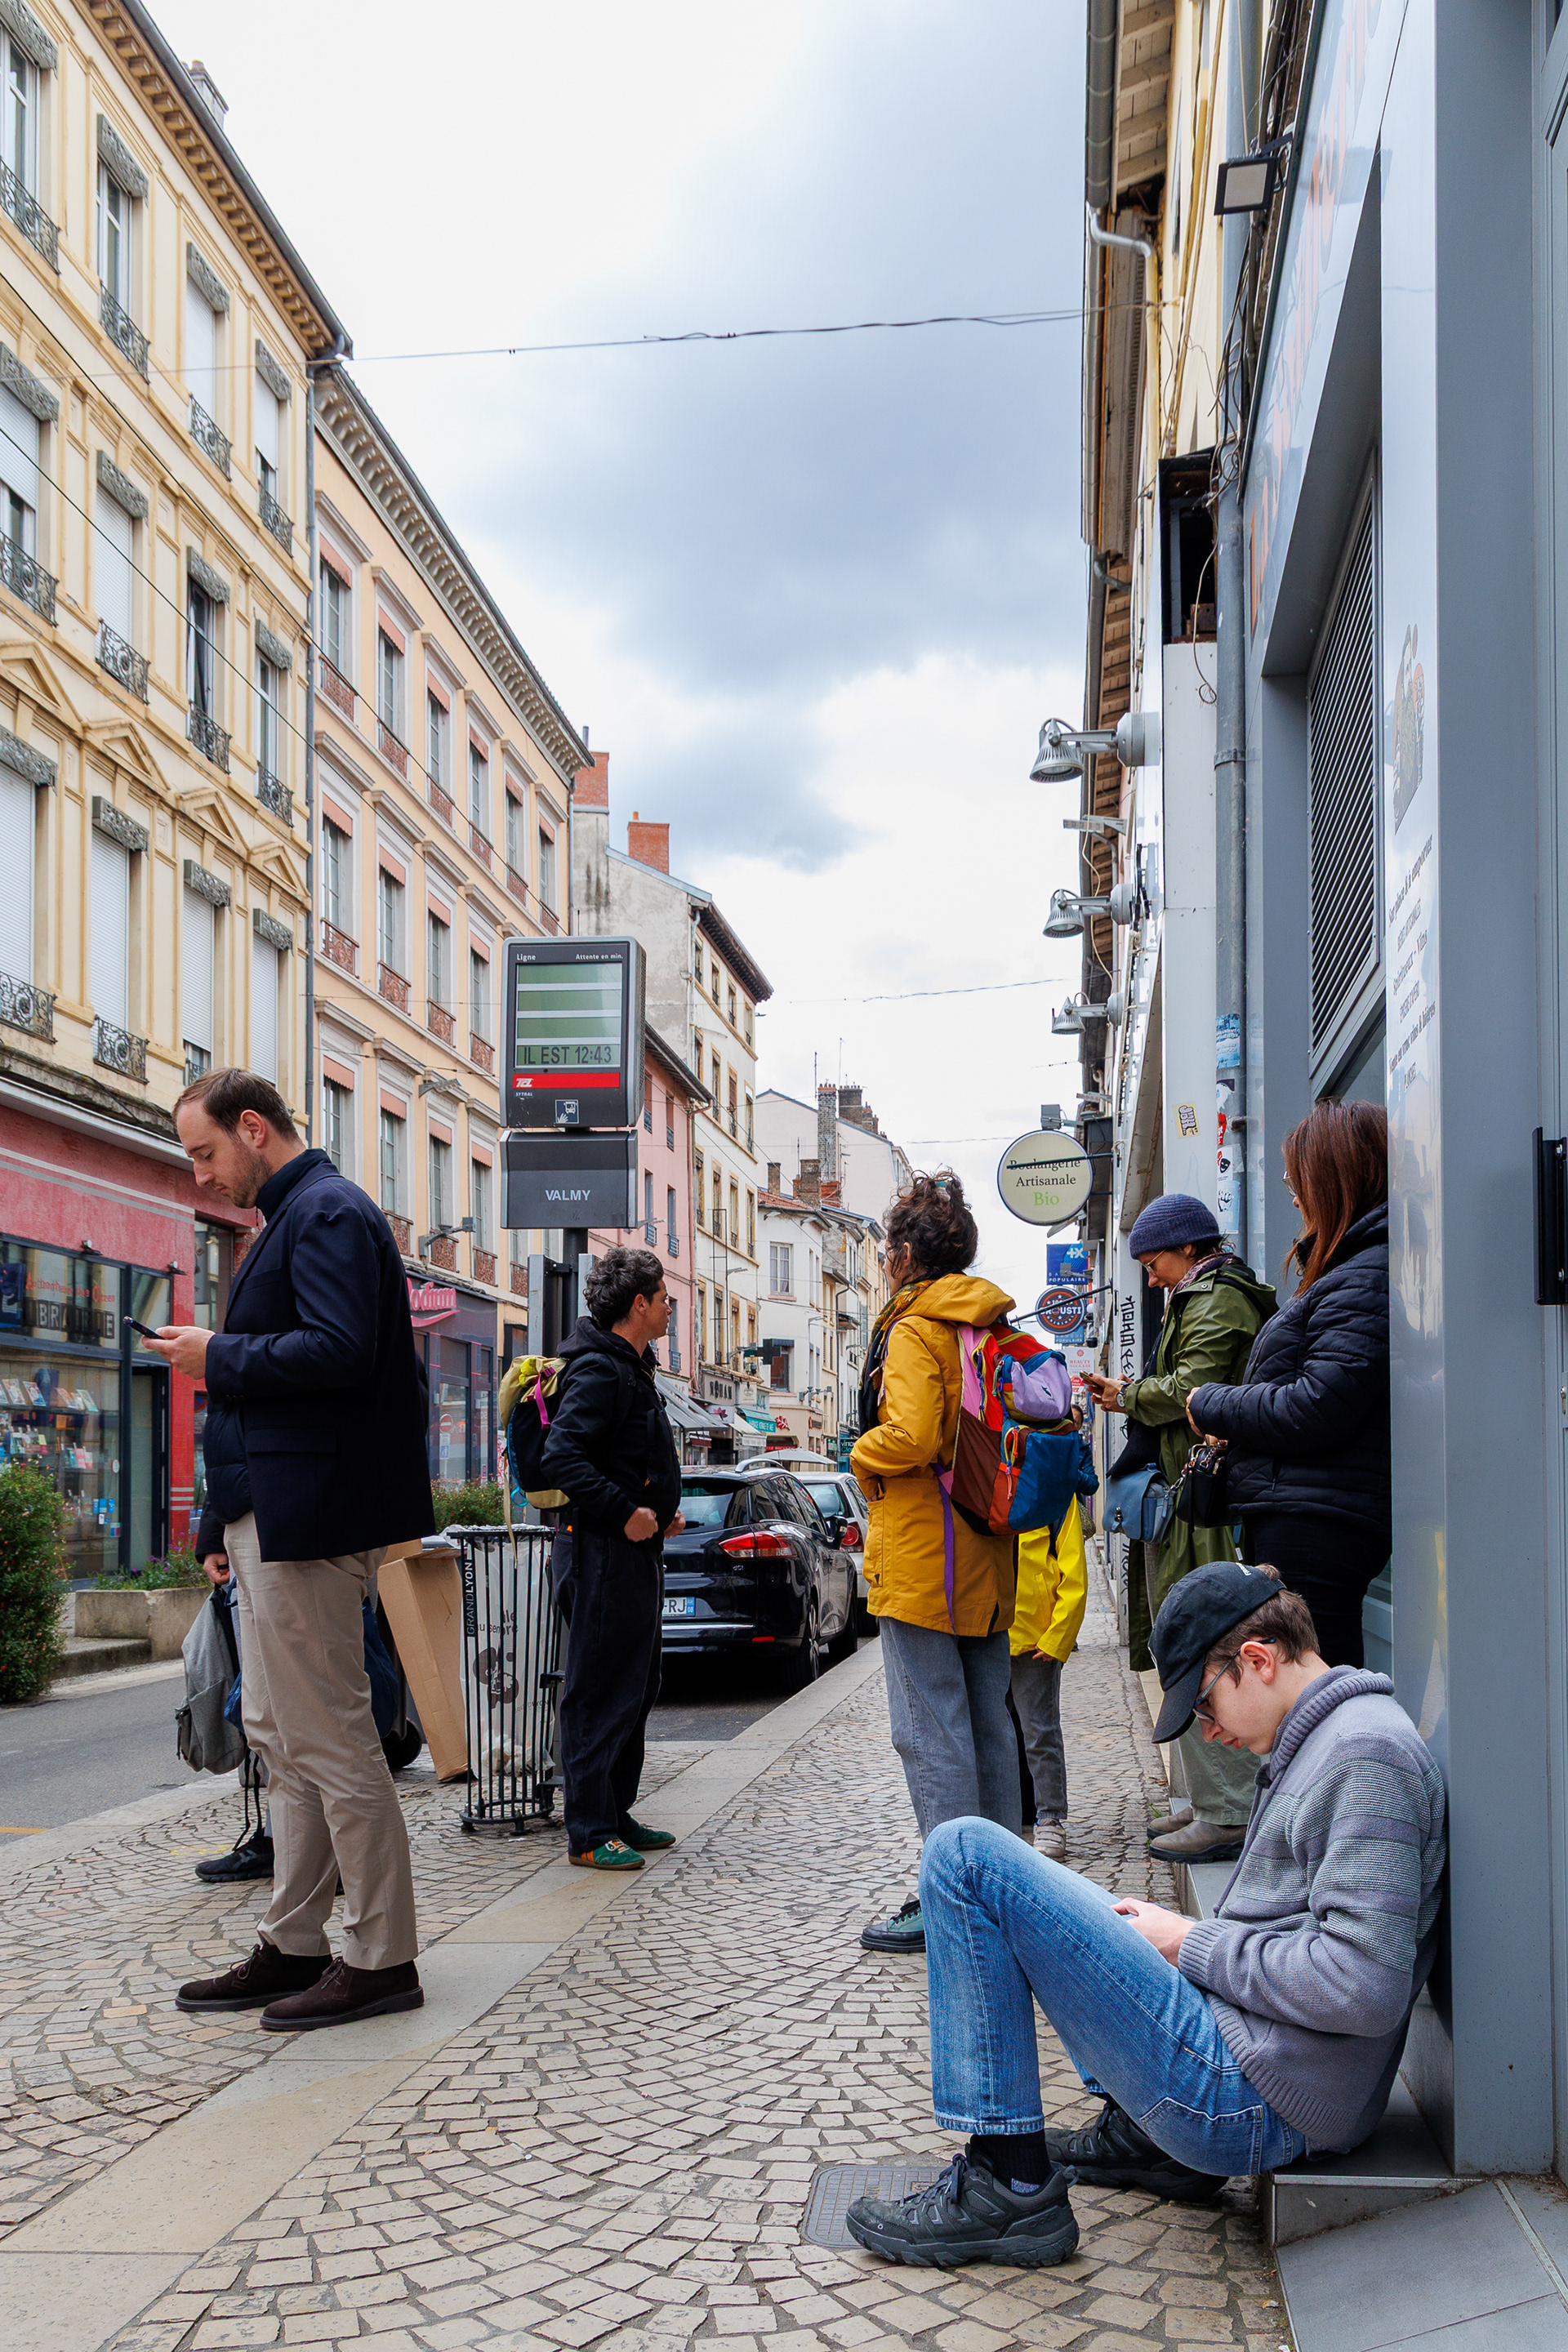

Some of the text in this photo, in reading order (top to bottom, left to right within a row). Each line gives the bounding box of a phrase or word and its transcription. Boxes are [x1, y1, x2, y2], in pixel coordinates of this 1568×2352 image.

[1395, 884, 1404, 920] place
[1411, 833, 1432, 884] emporter
[516, 953, 537, 961] Ligne
[523, 1045, 612, 1064] IL EST 12:43
[1015, 1174, 1076, 1187] Artisanale
[545, 1189, 591, 1201] VALMY
[1033, 1192, 1060, 1205] Bio
